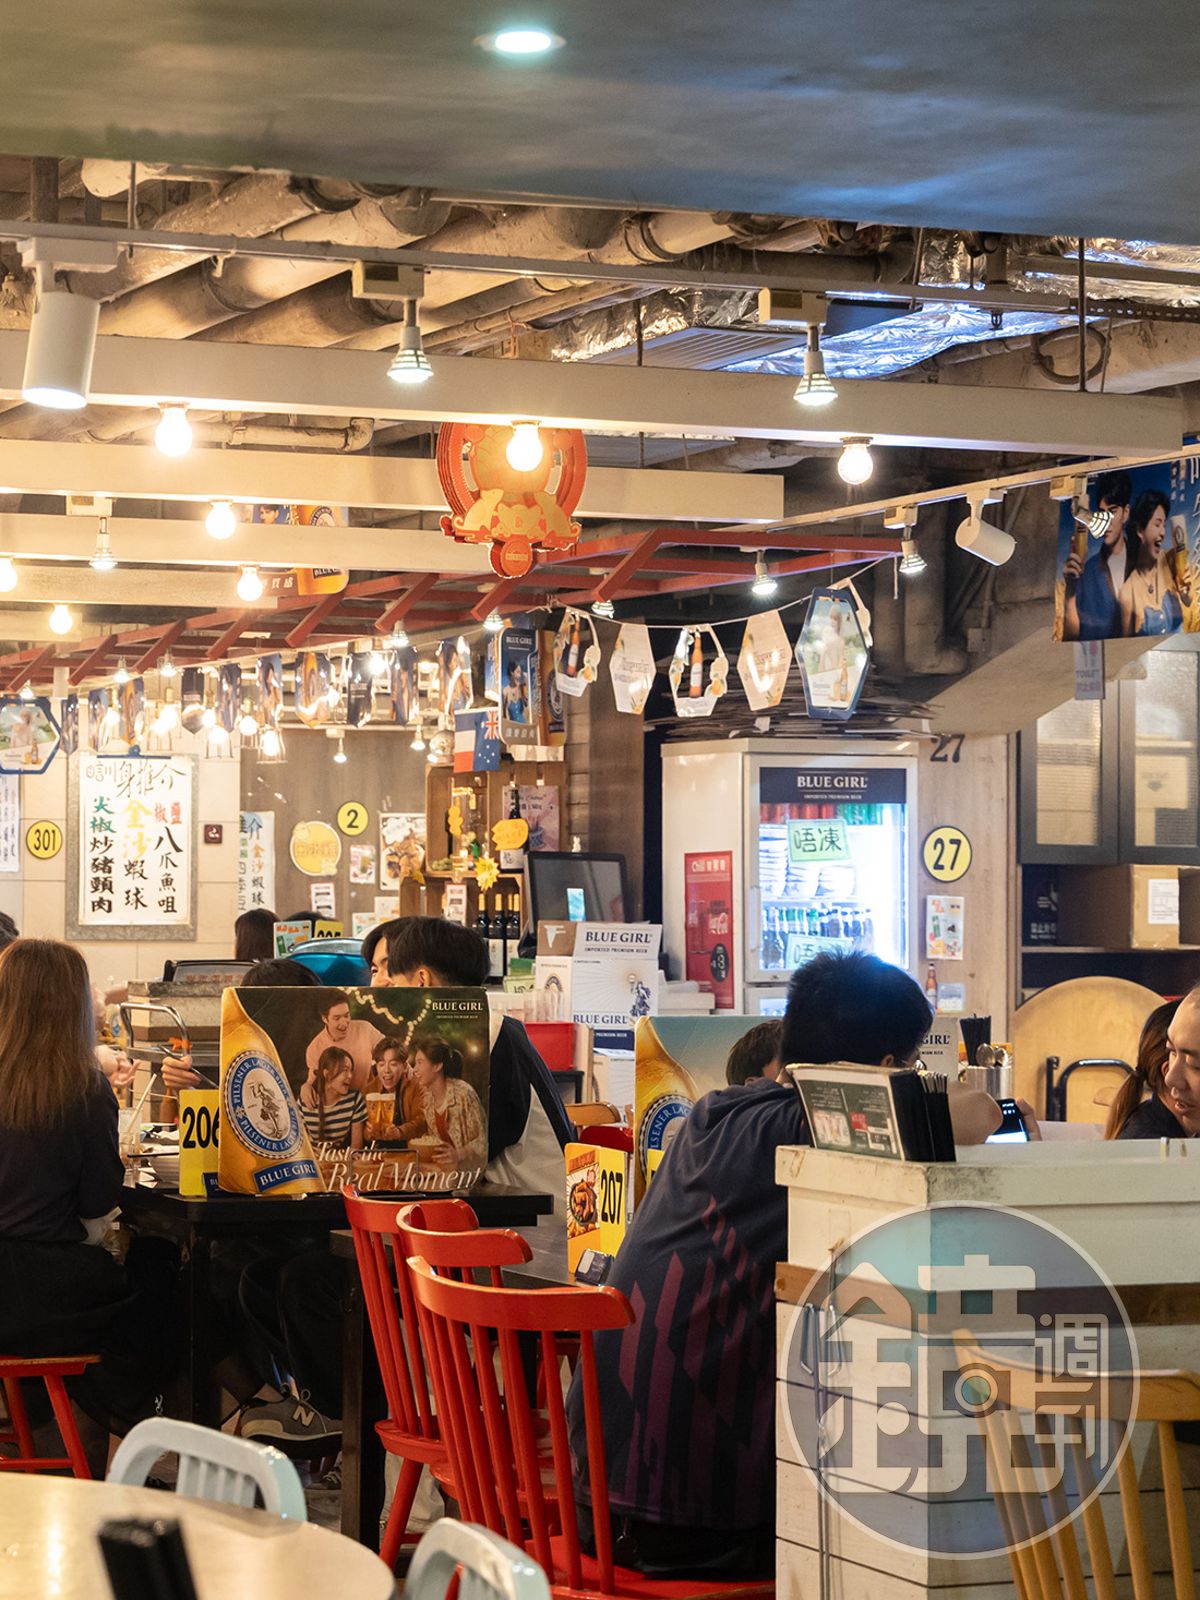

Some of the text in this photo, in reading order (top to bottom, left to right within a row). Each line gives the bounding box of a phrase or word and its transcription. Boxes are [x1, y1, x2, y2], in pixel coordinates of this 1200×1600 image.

[930, 734, 965, 763] 27
[797, 775, 868, 788] BLUE GIRL
[346, 809, 360, 829] 2
[33, 828, 56, 851] 301
[793, 826, 842, 853] 唔凍
[933, 837, 962, 871] 27
[585, 931, 651, 944] BLUE GIRL
[432, 1001, 483, 1011] BLUE GIRL
[573, 1014, 628, 1024] BLUE GIRL
[233, 1062, 253, 1104] PILSENER
[240, 1120, 279, 1151] PILSENER
[650, 1109, 672, 1148] LSENER
[260, 1161, 316, 1186] BLUE GIRL
[328, 1162, 481, 1192] Real Moment
[600, 1168, 624, 1226] 207
